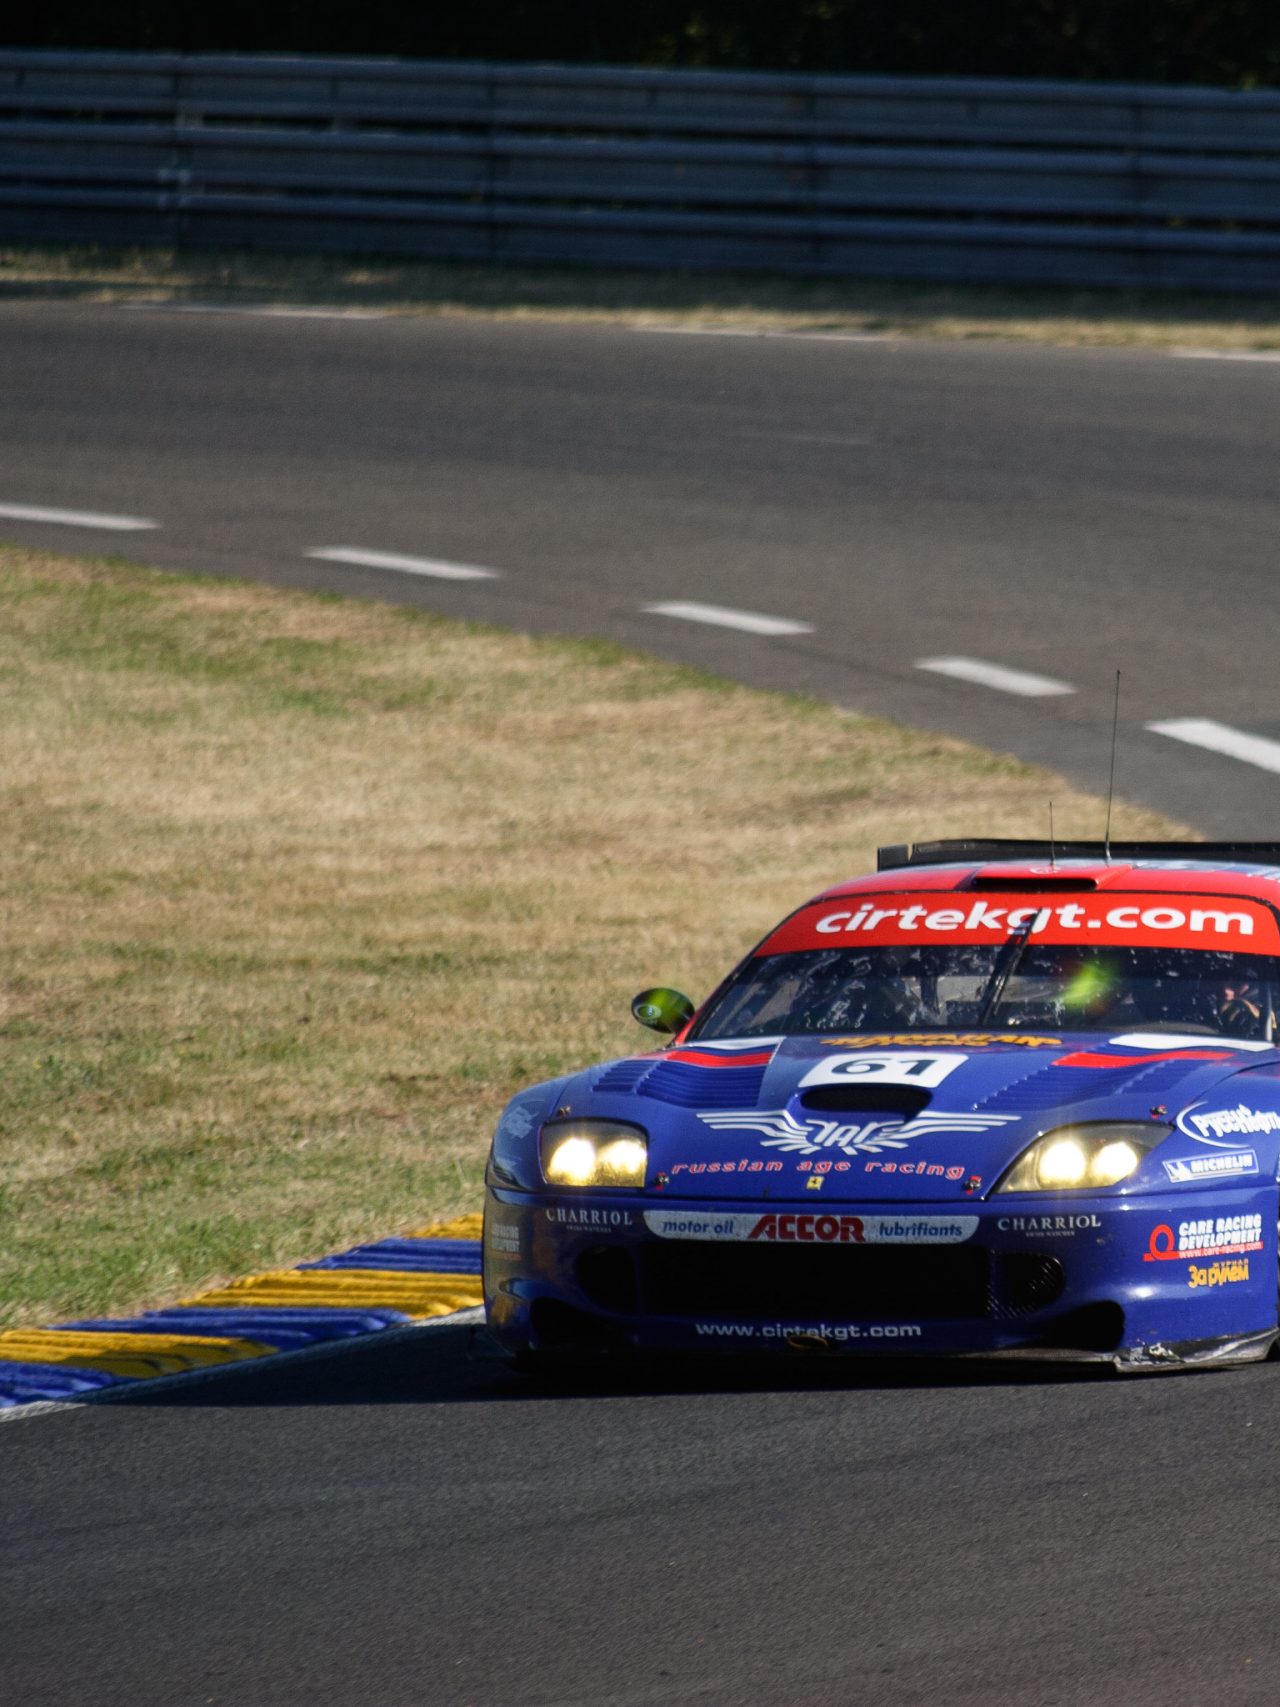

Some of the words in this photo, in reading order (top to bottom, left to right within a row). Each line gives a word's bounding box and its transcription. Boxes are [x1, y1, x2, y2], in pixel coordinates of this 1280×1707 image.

[815, 900, 1255, 936] cirtekgt.com
[832, 1057, 938, 1077] 61
[671, 1158, 783, 1175] russian
[796, 1160, 851, 1175] age
[865, 1160, 965, 1180] racing
[1190, 1153, 1253, 1173] MICHELIN
[546, 1208, 633, 1226] CHARRIOL
[663, 1219, 709, 1235] motor
[714, 1219, 734, 1235] oil
[997, 1214, 1102, 1231] CHARRIOL
[1179, 1219, 1214, 1236] CARE
[1216, 1213, 1262, 1233] RACING
[747, 1214, 866, 1242] ACCOR
[879, 1220, 963, 1238] lubrifiants
[1179, 1228, 1262, 1250] DEVELOPMENT
[696, 1323, 922, 1340] www.cirtekgt.com
